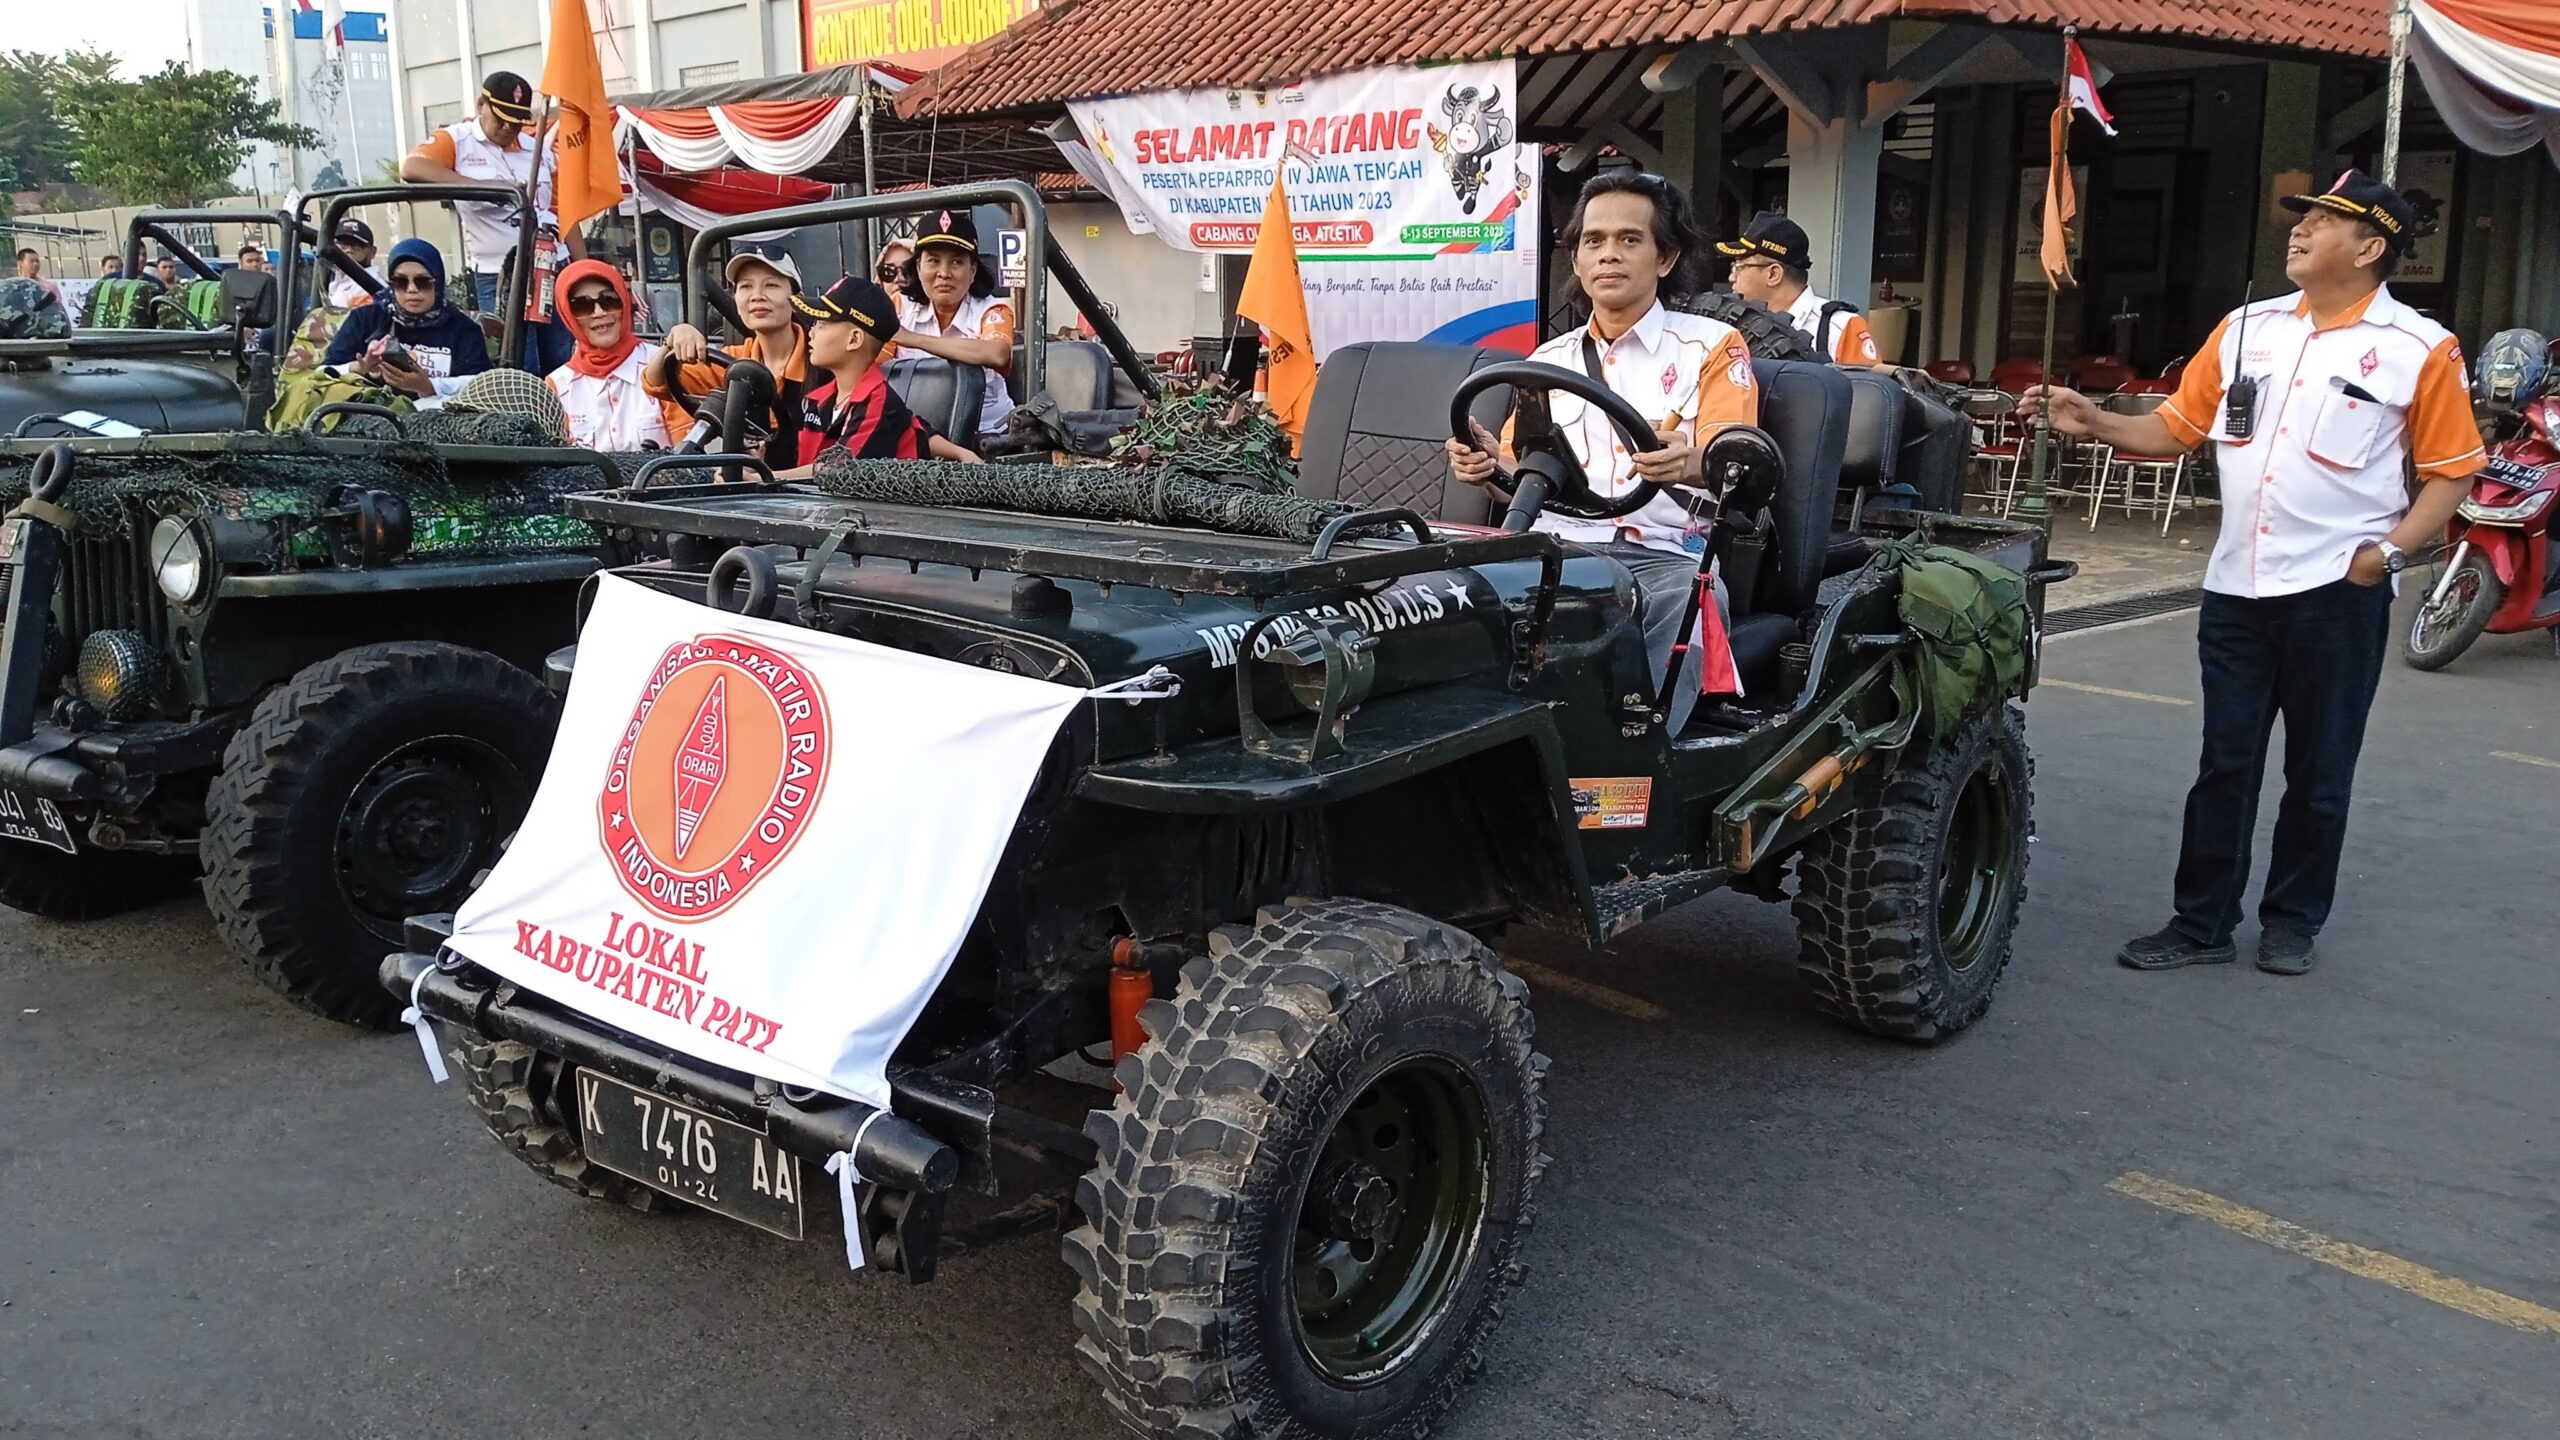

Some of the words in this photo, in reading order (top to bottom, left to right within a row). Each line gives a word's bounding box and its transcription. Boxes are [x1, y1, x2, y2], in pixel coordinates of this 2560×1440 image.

[813, 4, 895, 66] CONTINUE
[895, 0, 934, 55] OUR
[1134, 121, 1275, 165] SELAMAT
[1286, 108, 1423, 155] DATANG
[1142, 172, 1197, 189] PESERTA
[1199, 169, 1277, 188] PEPARPRO
[1288, 167, 1301, 184] IV
[1307, 164, 1350, 184] JAWA
[1354, 160, 1422, 181] TENGAH
[1170, 198, 1183, 213] DI
[1187, 197, 1262, 214] KABUPATEN
[1301, 193, 1353, 211] TAHUN
[1358, 191, 1392, 210] 2023
[1197, 226, 1244, 241] CABANG
[1316, 225, 1363, 241] ATLETIK
[1422, 226, 1480, 239] SEPTEMBER
[1483, 225, 1504, 238] 2023
[1002, 234, 1020, 267] P
[1371, 278, 1395, 295] Tanpa
[1400, 277, 1425, 292] Batas
[416, 344, 451, 354] WORLD
[682, 755, 719, 778] ORARI
[758, 732, 816, 844] RADIO
[619, 836, 732, 909] INDONESIA
[602, 911, 709, 985] LOKAL
[513, 919, 705, 1025] KABUPATEN
[701, 996, 783, 1054] PATI
[582, 1077, 605, 1135] K
[633, 1095, 717, 1175] 7476
[752, 1137, 795, 1204] AA
